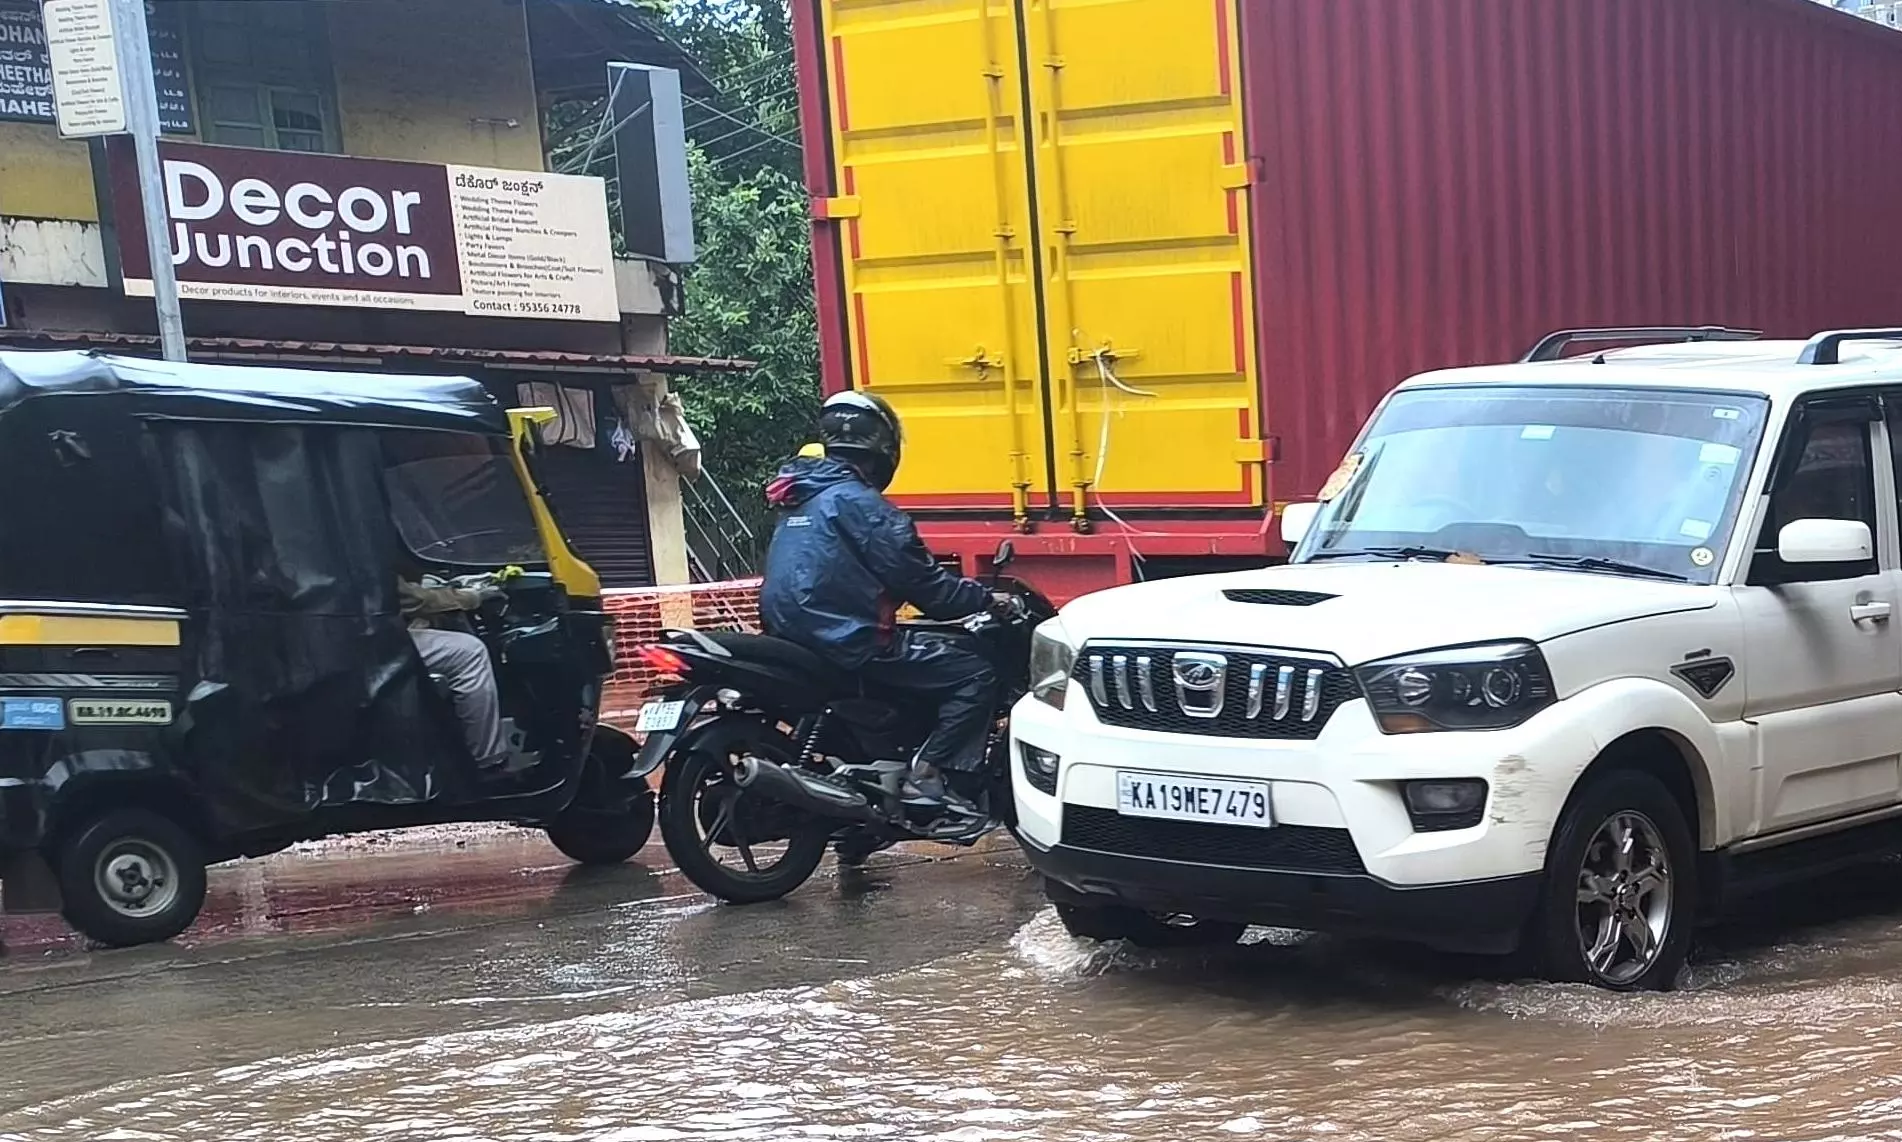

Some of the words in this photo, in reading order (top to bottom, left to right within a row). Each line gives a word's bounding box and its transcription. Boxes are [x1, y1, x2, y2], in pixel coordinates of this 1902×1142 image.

[163, 159, 421, 234] Decor
[460, 196, 488, 204] Wedding
[514, 200, 538, 208] Flowers
[462, 205, 490, 214] Wedding
[462, 214, 490, 222] Artificial
[512, 218, 538, 226] Bouquet
[550, 230, 578, 238] Creepers
[172, 222, 431, 278] Junction
[466, 242, 482, 250] Party
[470, 270, 496, 278] Artificial
[498, 271, 522, 279] Flowers
[556, 274, 574, 282] Crafts
[182, 284, 210, 295] Decor
[212, 286, 253, 299] products
[255, 289, 268, 298] for
[312, 293, 340, 302] events
[342, 294, 358, 302] and
[361, 294, 371, 303] all
[373, 296, 416, 306] occasions
[474, 300, 511, 312] Contact
[520, 302, 550, 313] 95356
[552, 304, 581, 314] 24778
[1131, 781, 1265, 819] KA19ME7479
